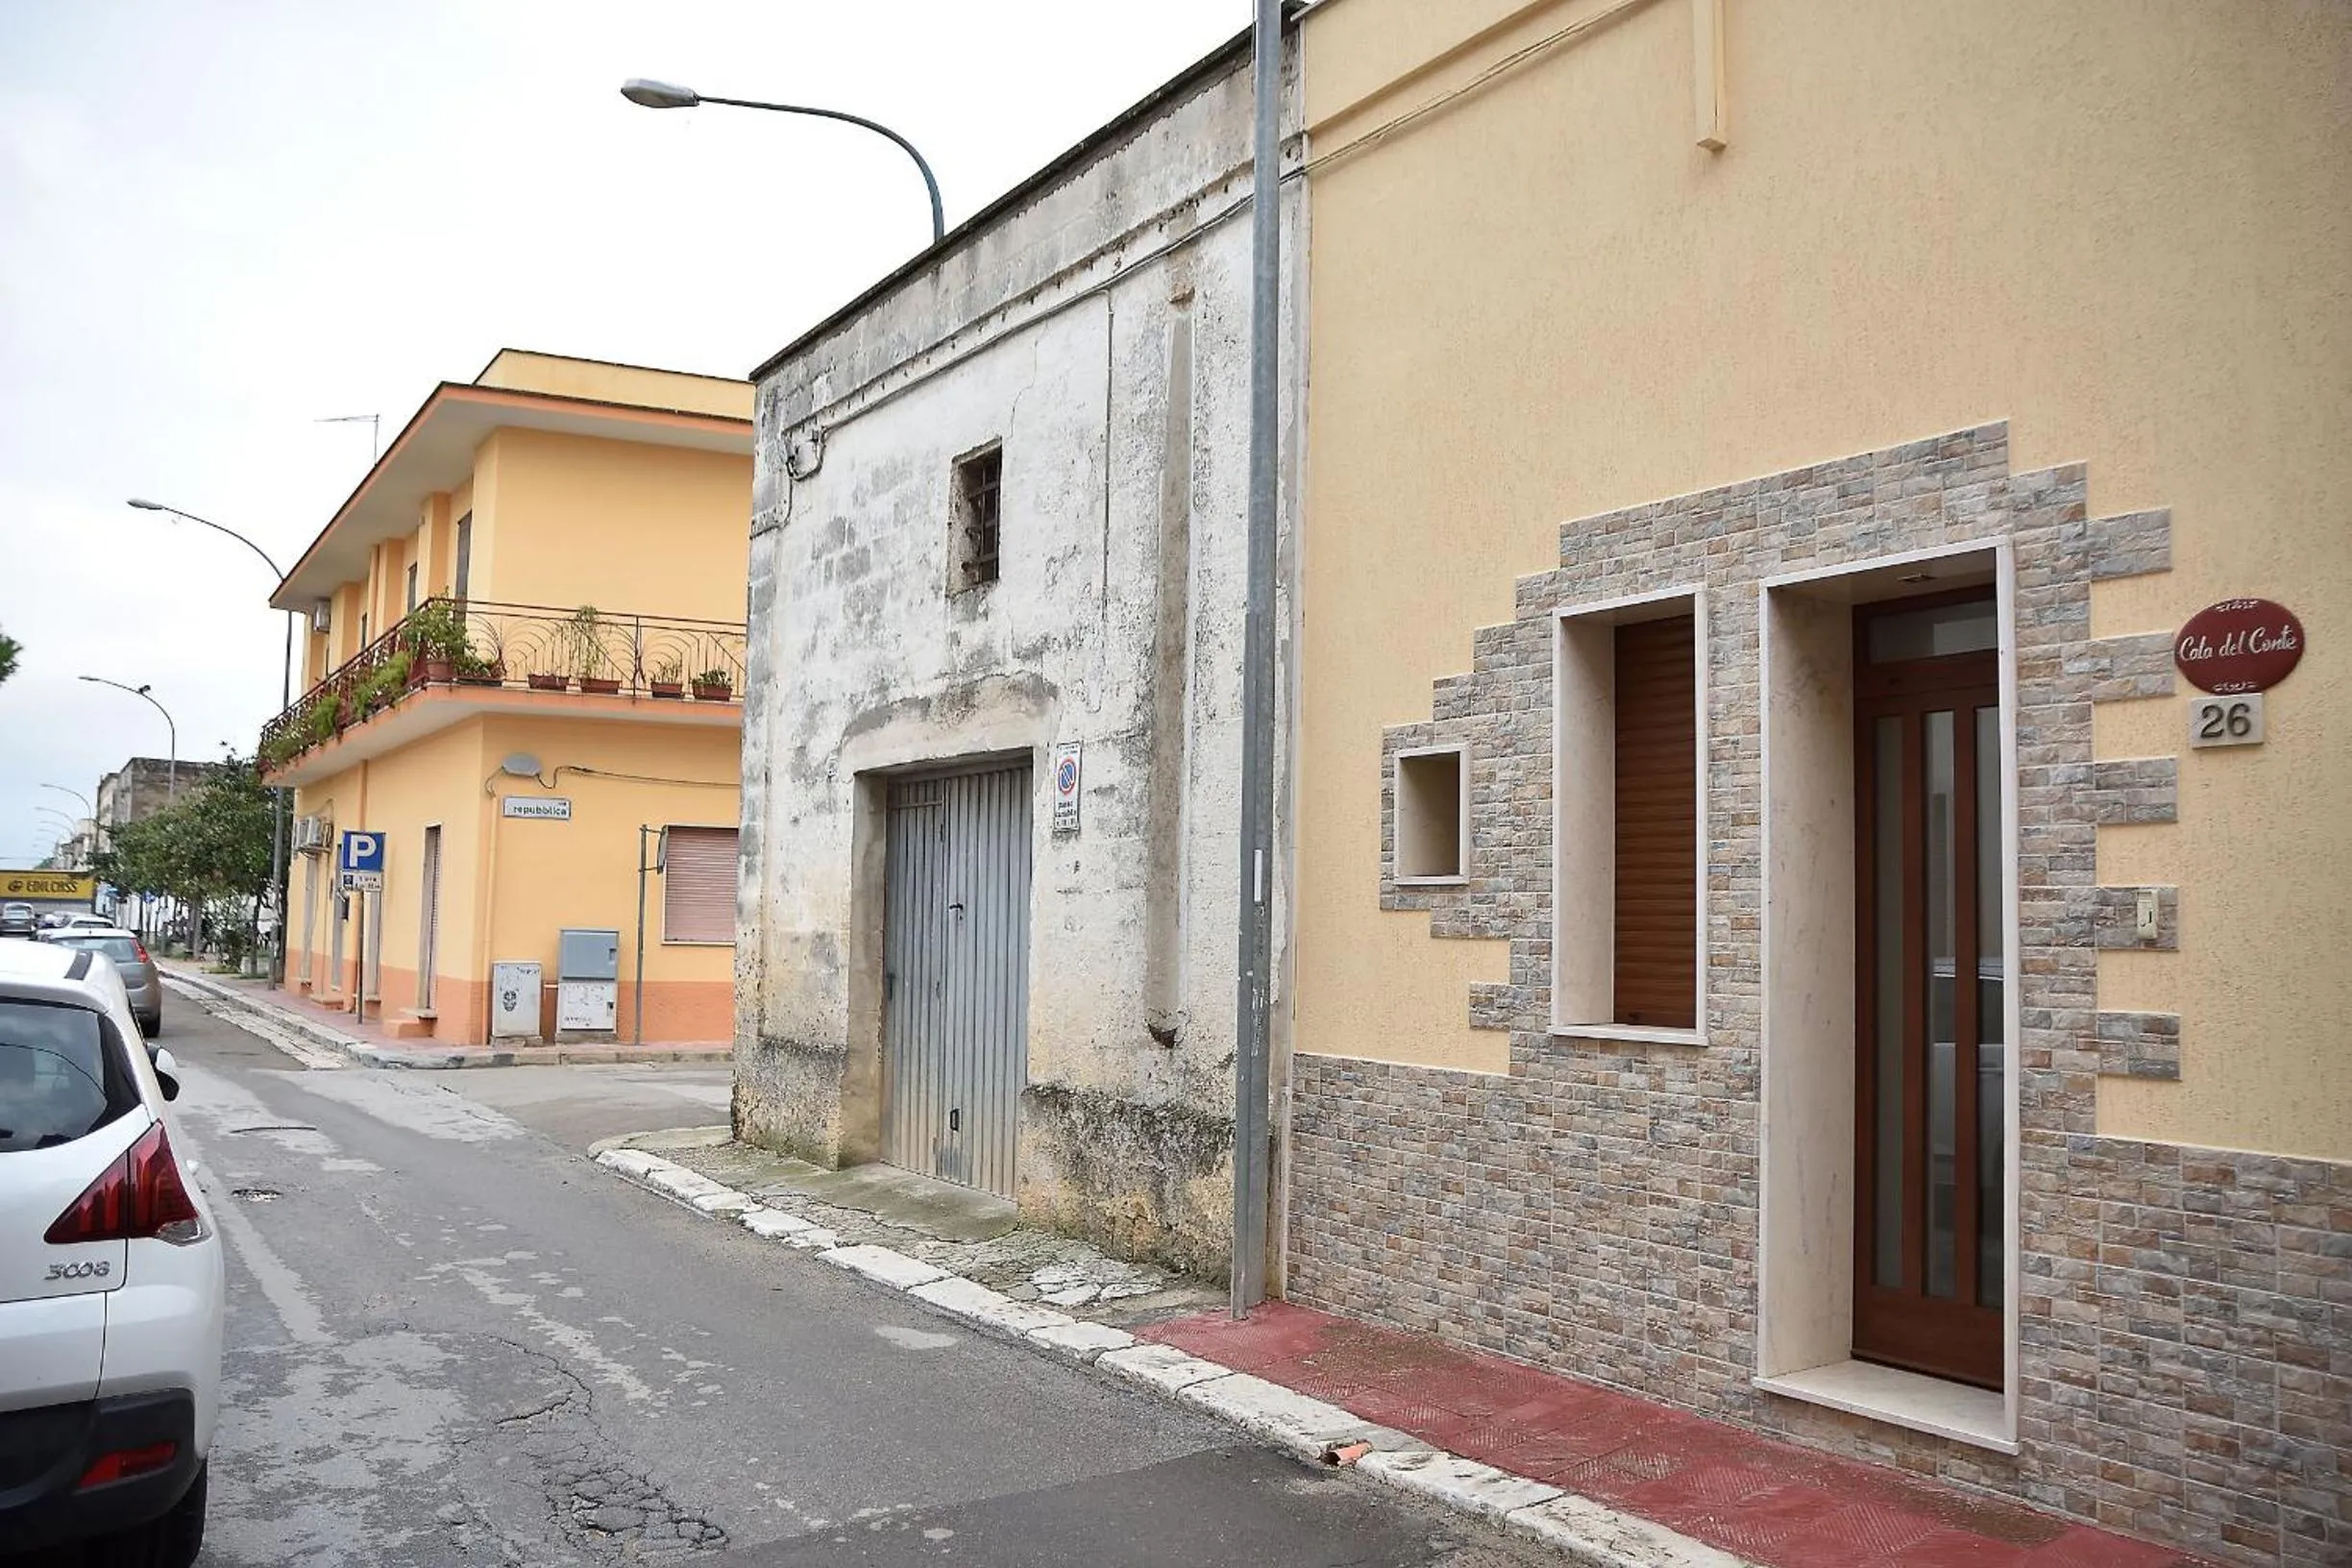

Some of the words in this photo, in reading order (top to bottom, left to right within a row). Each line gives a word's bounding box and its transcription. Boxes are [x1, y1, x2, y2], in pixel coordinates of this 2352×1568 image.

[2218, 630, 2246, 657] del
[2248, 625, 2297, 654] Conte
[2200, 702, 2251, 739] 26
[513, 805, 567, 816] repubblica
[350, 835, 377, 867] P
[44, 1261, 110, 1281] 3008
